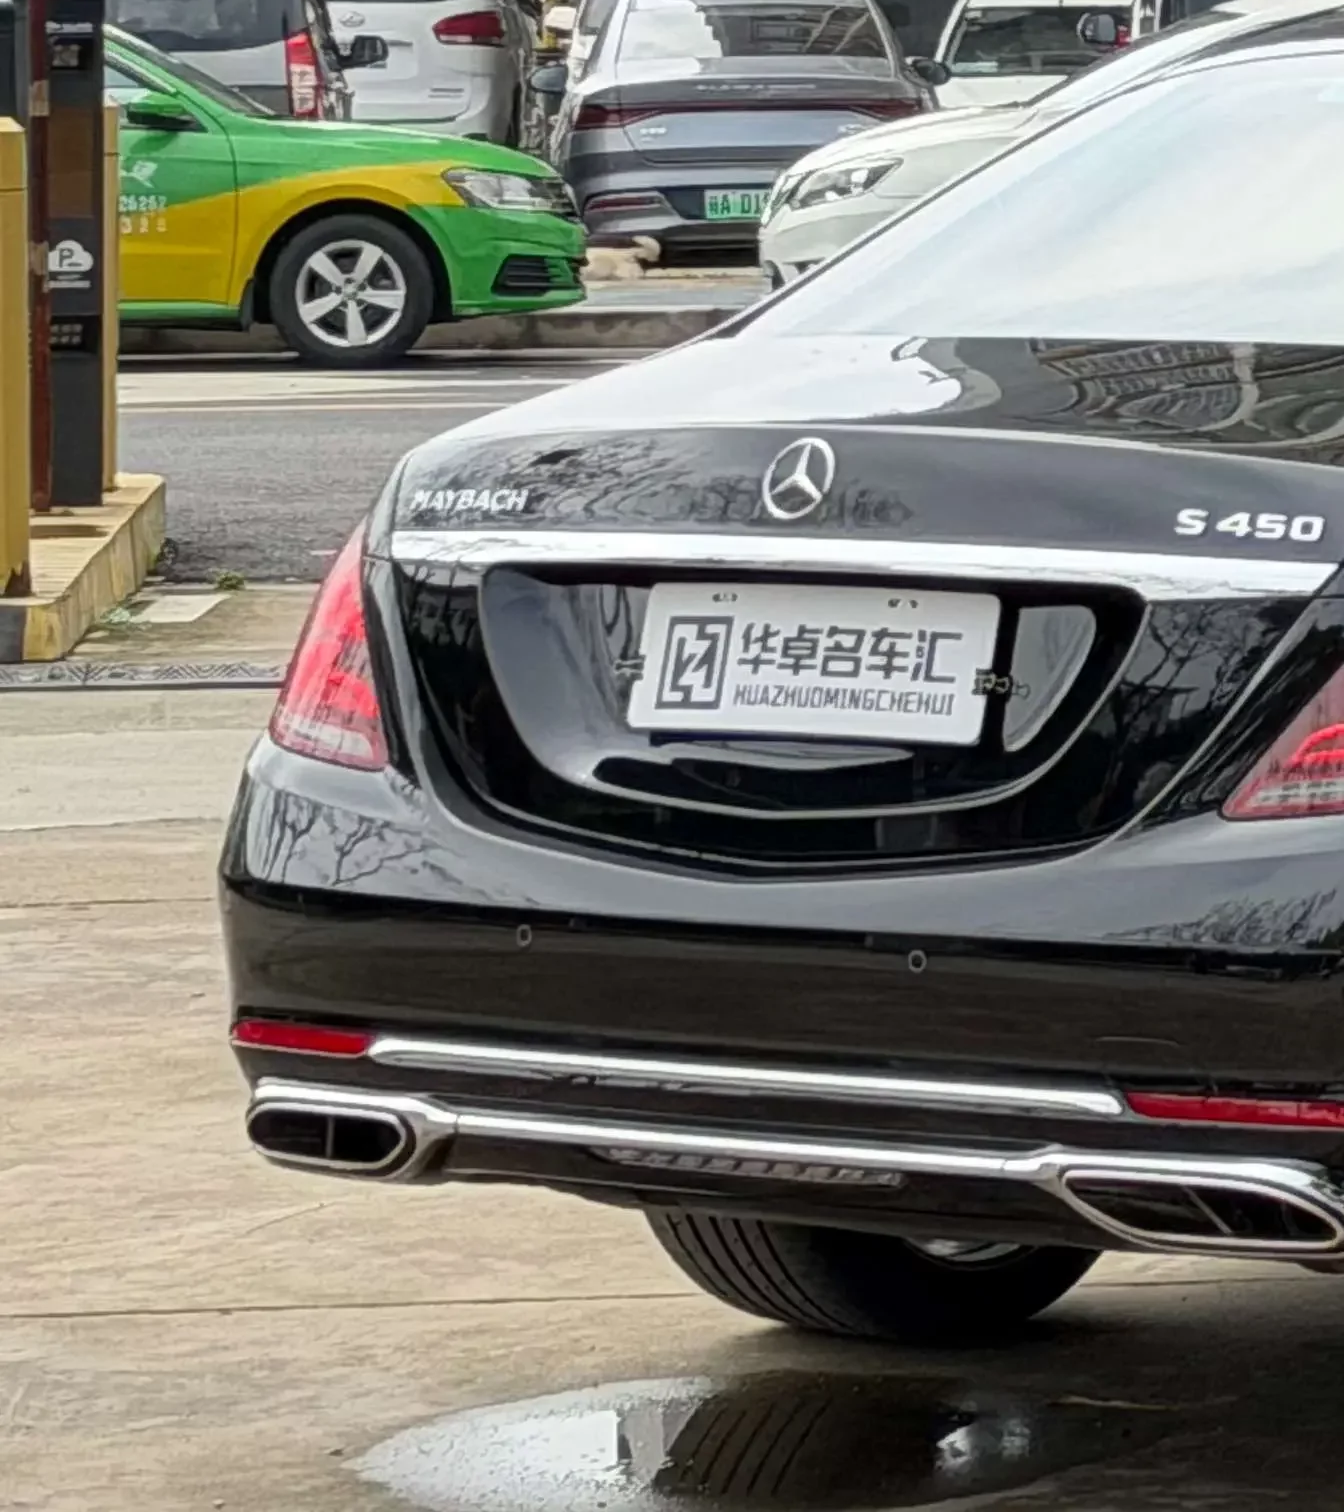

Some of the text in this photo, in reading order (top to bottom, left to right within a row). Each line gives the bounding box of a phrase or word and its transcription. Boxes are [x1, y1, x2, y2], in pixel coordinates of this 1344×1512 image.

[409, 488, 529, 513] MAYBACH
[1174, 508, 1325, 542] S 450
[737, 622, 963, 684] 华卓名车汇
[732, 684, 955, 717] HUAZHUOMINGCHEHUI
